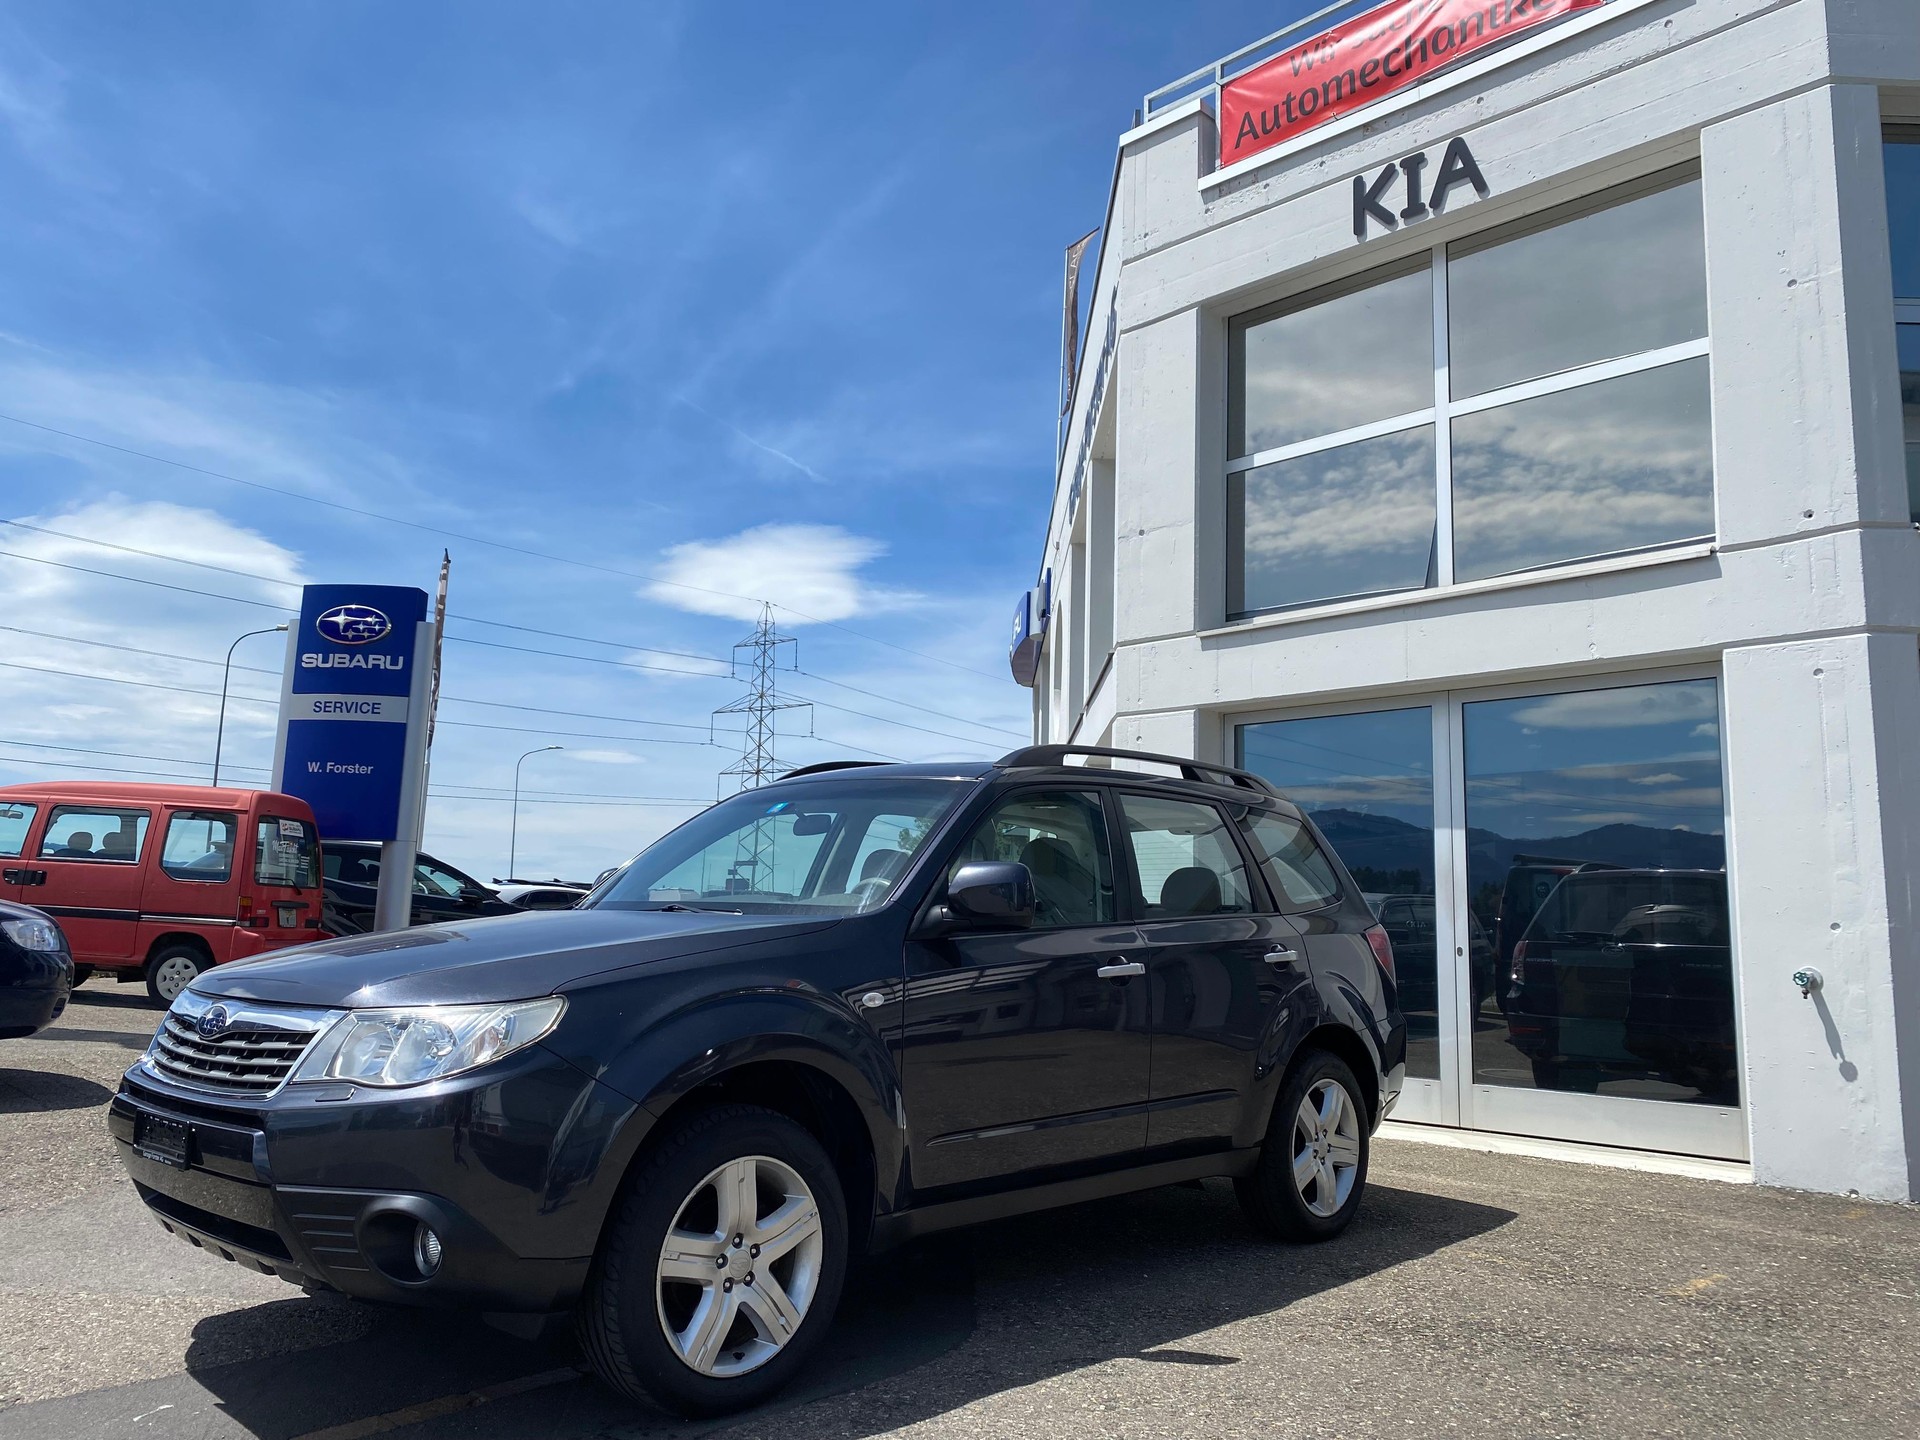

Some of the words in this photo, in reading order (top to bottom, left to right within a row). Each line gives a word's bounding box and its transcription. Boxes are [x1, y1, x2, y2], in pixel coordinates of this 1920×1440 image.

[1353, 136, 1488, 240] KIA
[301, 653, 404, 670] SUBARU
[312, 701, 381, 715] SERVICE
[307, 761, 322, 773] W.
[326, 762, 374, 775] Forster
